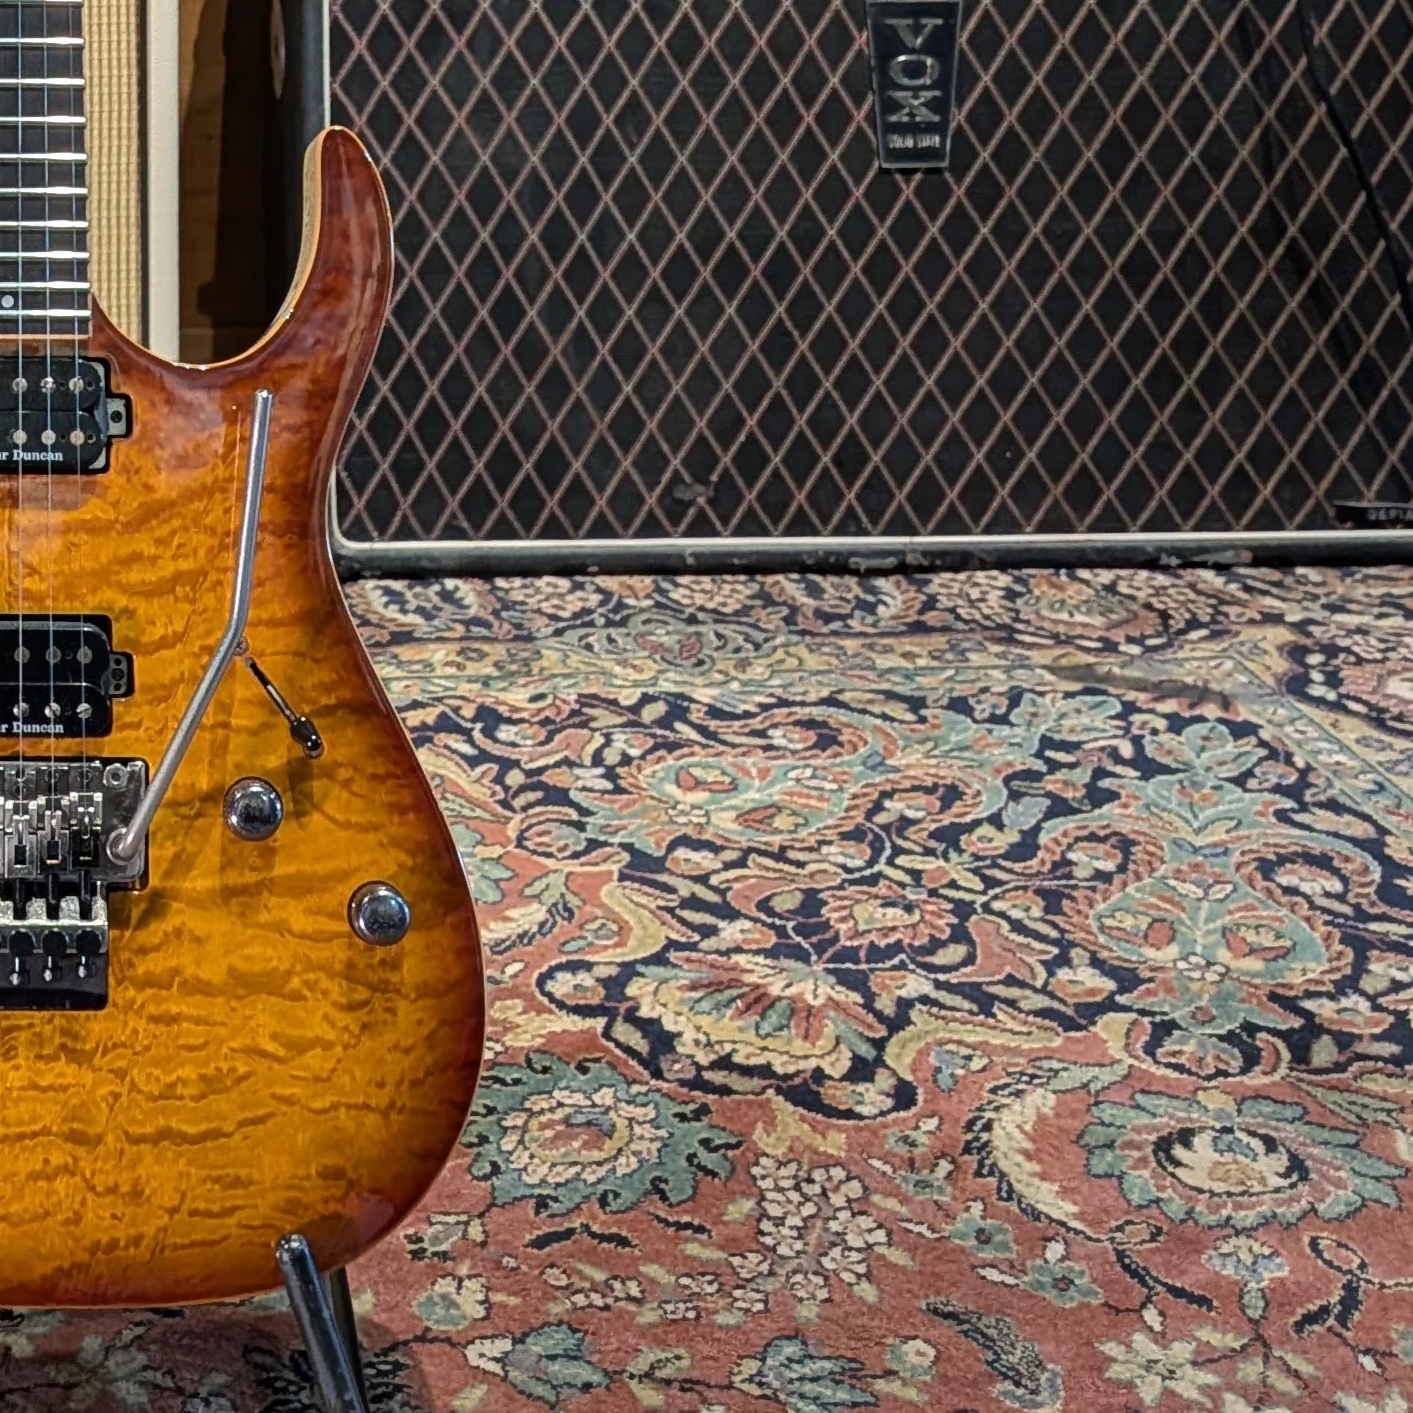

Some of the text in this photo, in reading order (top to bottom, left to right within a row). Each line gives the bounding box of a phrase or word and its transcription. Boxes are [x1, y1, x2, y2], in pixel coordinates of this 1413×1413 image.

[884, 17, 944, 122] VOX
[12, 449, 64, 462] Duncan
[11, 721, 64, 734] Duncan
